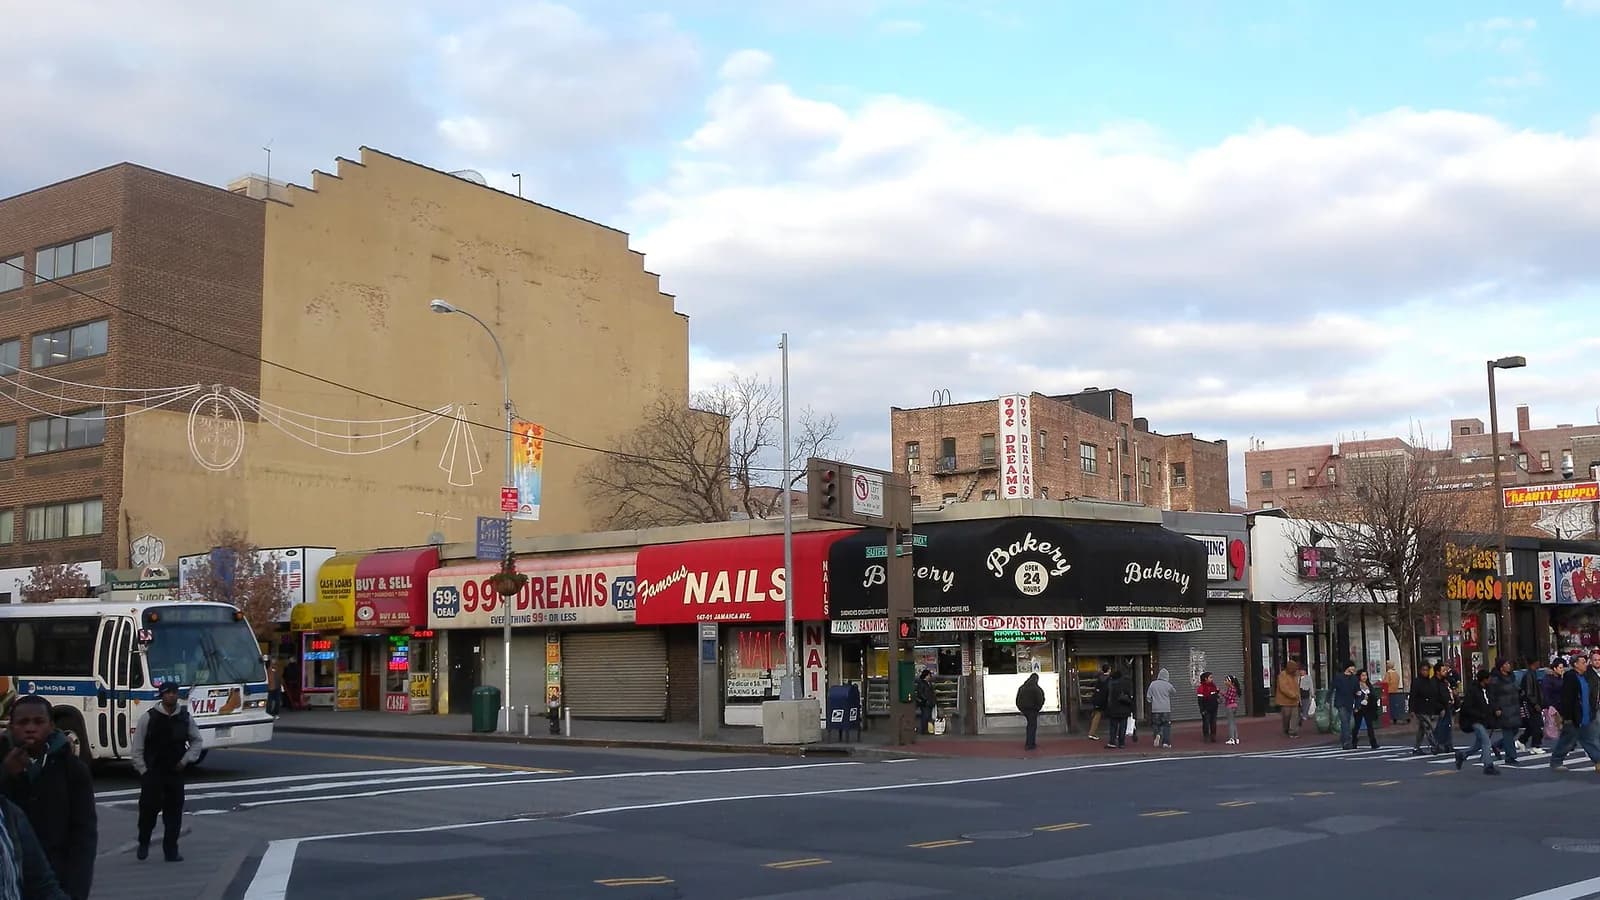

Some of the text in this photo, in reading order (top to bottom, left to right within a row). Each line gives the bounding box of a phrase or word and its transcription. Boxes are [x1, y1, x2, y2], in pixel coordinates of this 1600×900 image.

[1005, 434, 1018, 495] DREAMS
[1021, 434, 1031, 495] DREAMS
[1511, 487, 1598, 503] BEAUTY SUPPLY
[866, 548, 888, 557] SUTPH
[986, 531, 1072, 578] Bakery
[319, 578, 352, 588] CASH LOANS
[356, 575, 412, 591] BUY & SELL
[637, 564, 688, 604] Famous
[863, 564, 954, 592] Bery
[1023, 572, 1041, 585] 24
[1124, 561, 1190, 594] Bakery
[517, 572, 609, 611] DREAMS
[683, 567, 786, 604] NAILS
[822, 559, 830, 615] NAILS
[1023, 585, 1041, 593] HOURS
[617, 599, 636, 609] DEA
[437, 607, 456, 617] DEAL
[549, 613, 559, 622] OR
[561, 612, 577, 621] LESS
[835, 618, 889, 632] TACOS SANDWICH
[952, 617, 976, 630] TORTAS
[1006, 617, 1047, 630] PASTRY
[1053, 617, 1083, 630] SHOP
[738, 631, 787, 671] NAILS
[410, 688, 429, 697] SELL
[191, 698, 217, 713] V.I.M.
